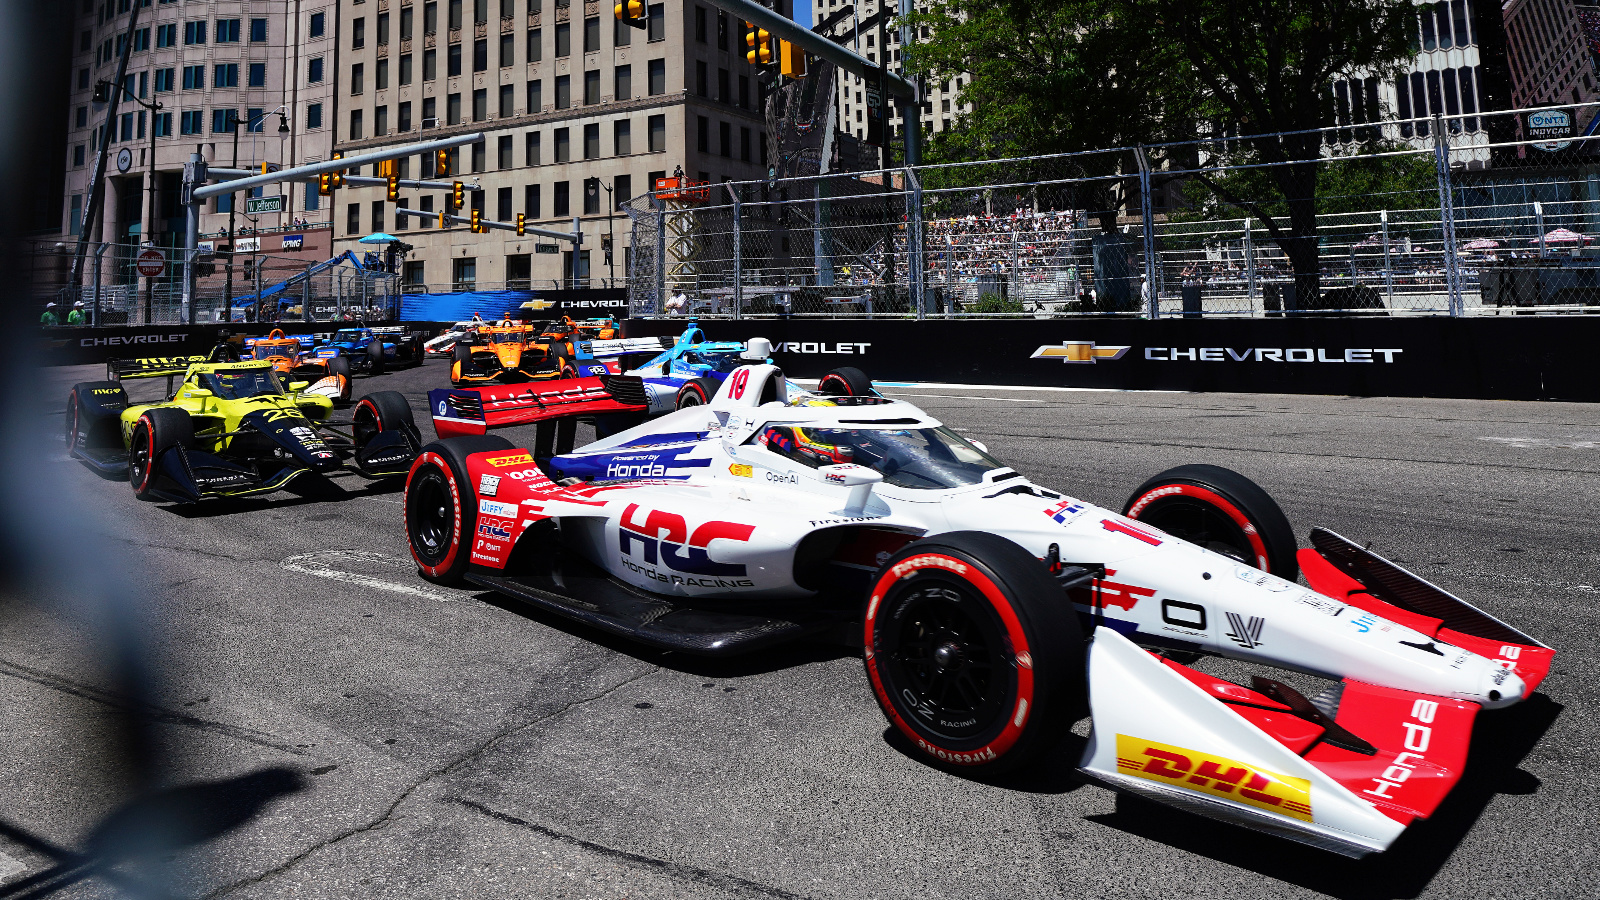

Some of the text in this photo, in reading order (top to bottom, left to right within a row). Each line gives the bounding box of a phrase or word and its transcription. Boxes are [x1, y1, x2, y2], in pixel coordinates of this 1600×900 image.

[1545, 116, 1566, 124] NTT
[1530, 127, 1571, 136] INDYCAR
[248, 199, 280, 212] W Jefferson
[281, 239, 301, 248] KPMG
[80, 333, 189, 347] CHEVROLET
[743, 342, 872, 355] VROLET
[1144, 346, 1404, 364] CHEVROLET
[91, 388, 113, 396] TWG
[727, 368, 750, 401] 10
[490, 386, 608, 407] Honda
[494, 455, 528, 466] DHL
[606, 461, 665, 478] Honda
[766, 471, 799, 486] OpenAI
[481, 501, 503, 515] JIFFY
[478, 517, 515, 538] HRC
[619, 502, 757, 577] HRC
[621, 556, 755, 588] Honda RACING
[940, 718, 977, 728] RACING
[918, 738, 997, 764] Firestone
[1363, 699, 1439, 799] Honda
[1141, 747, 1284, 806] DHL
